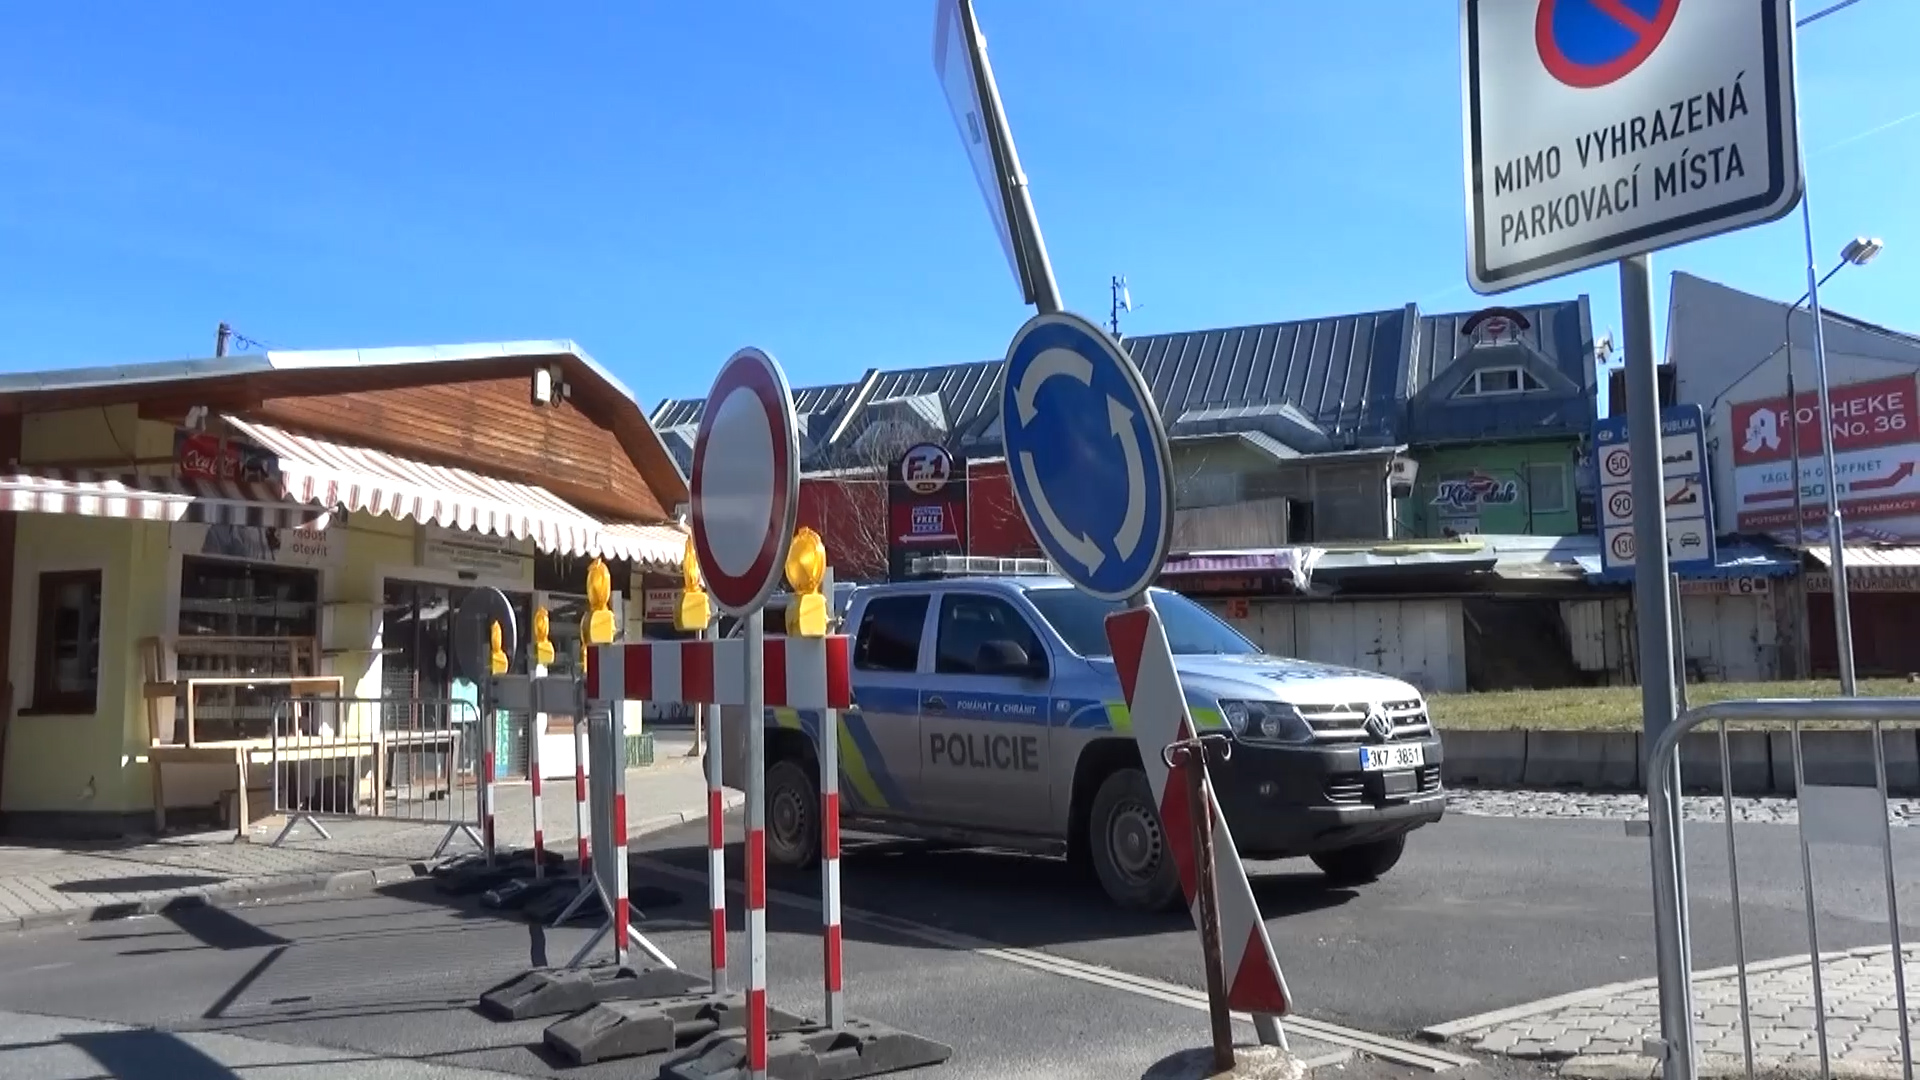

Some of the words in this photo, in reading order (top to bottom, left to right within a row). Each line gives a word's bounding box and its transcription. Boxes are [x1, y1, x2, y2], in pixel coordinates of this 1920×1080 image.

[1494, 145, 1561, 197] MIMO
[1576, 70, 1748, 169] VYHRAZENÁ
[1501, 163, 1641, 247] PARKOVACÍ
[1654, 142, 1744, 201] MÍSTA
[1874, 414, 1906, 433] 36
[1611, 456, 1628, 471] 50
[1800, 483, 1825, 497] 50
[1613, 497, 1631, 512] 90
[1857, 500, 1916, 514] PHARMACY
[1738, 575, 1753, 594] 6
[957, 699, 993, 712] POMÁHAT
[993, 703, 1001, 712] A
[1003, 702, 1037, 716] CHRÁNIT
[929, 732, 1040, 773] POLICIE
